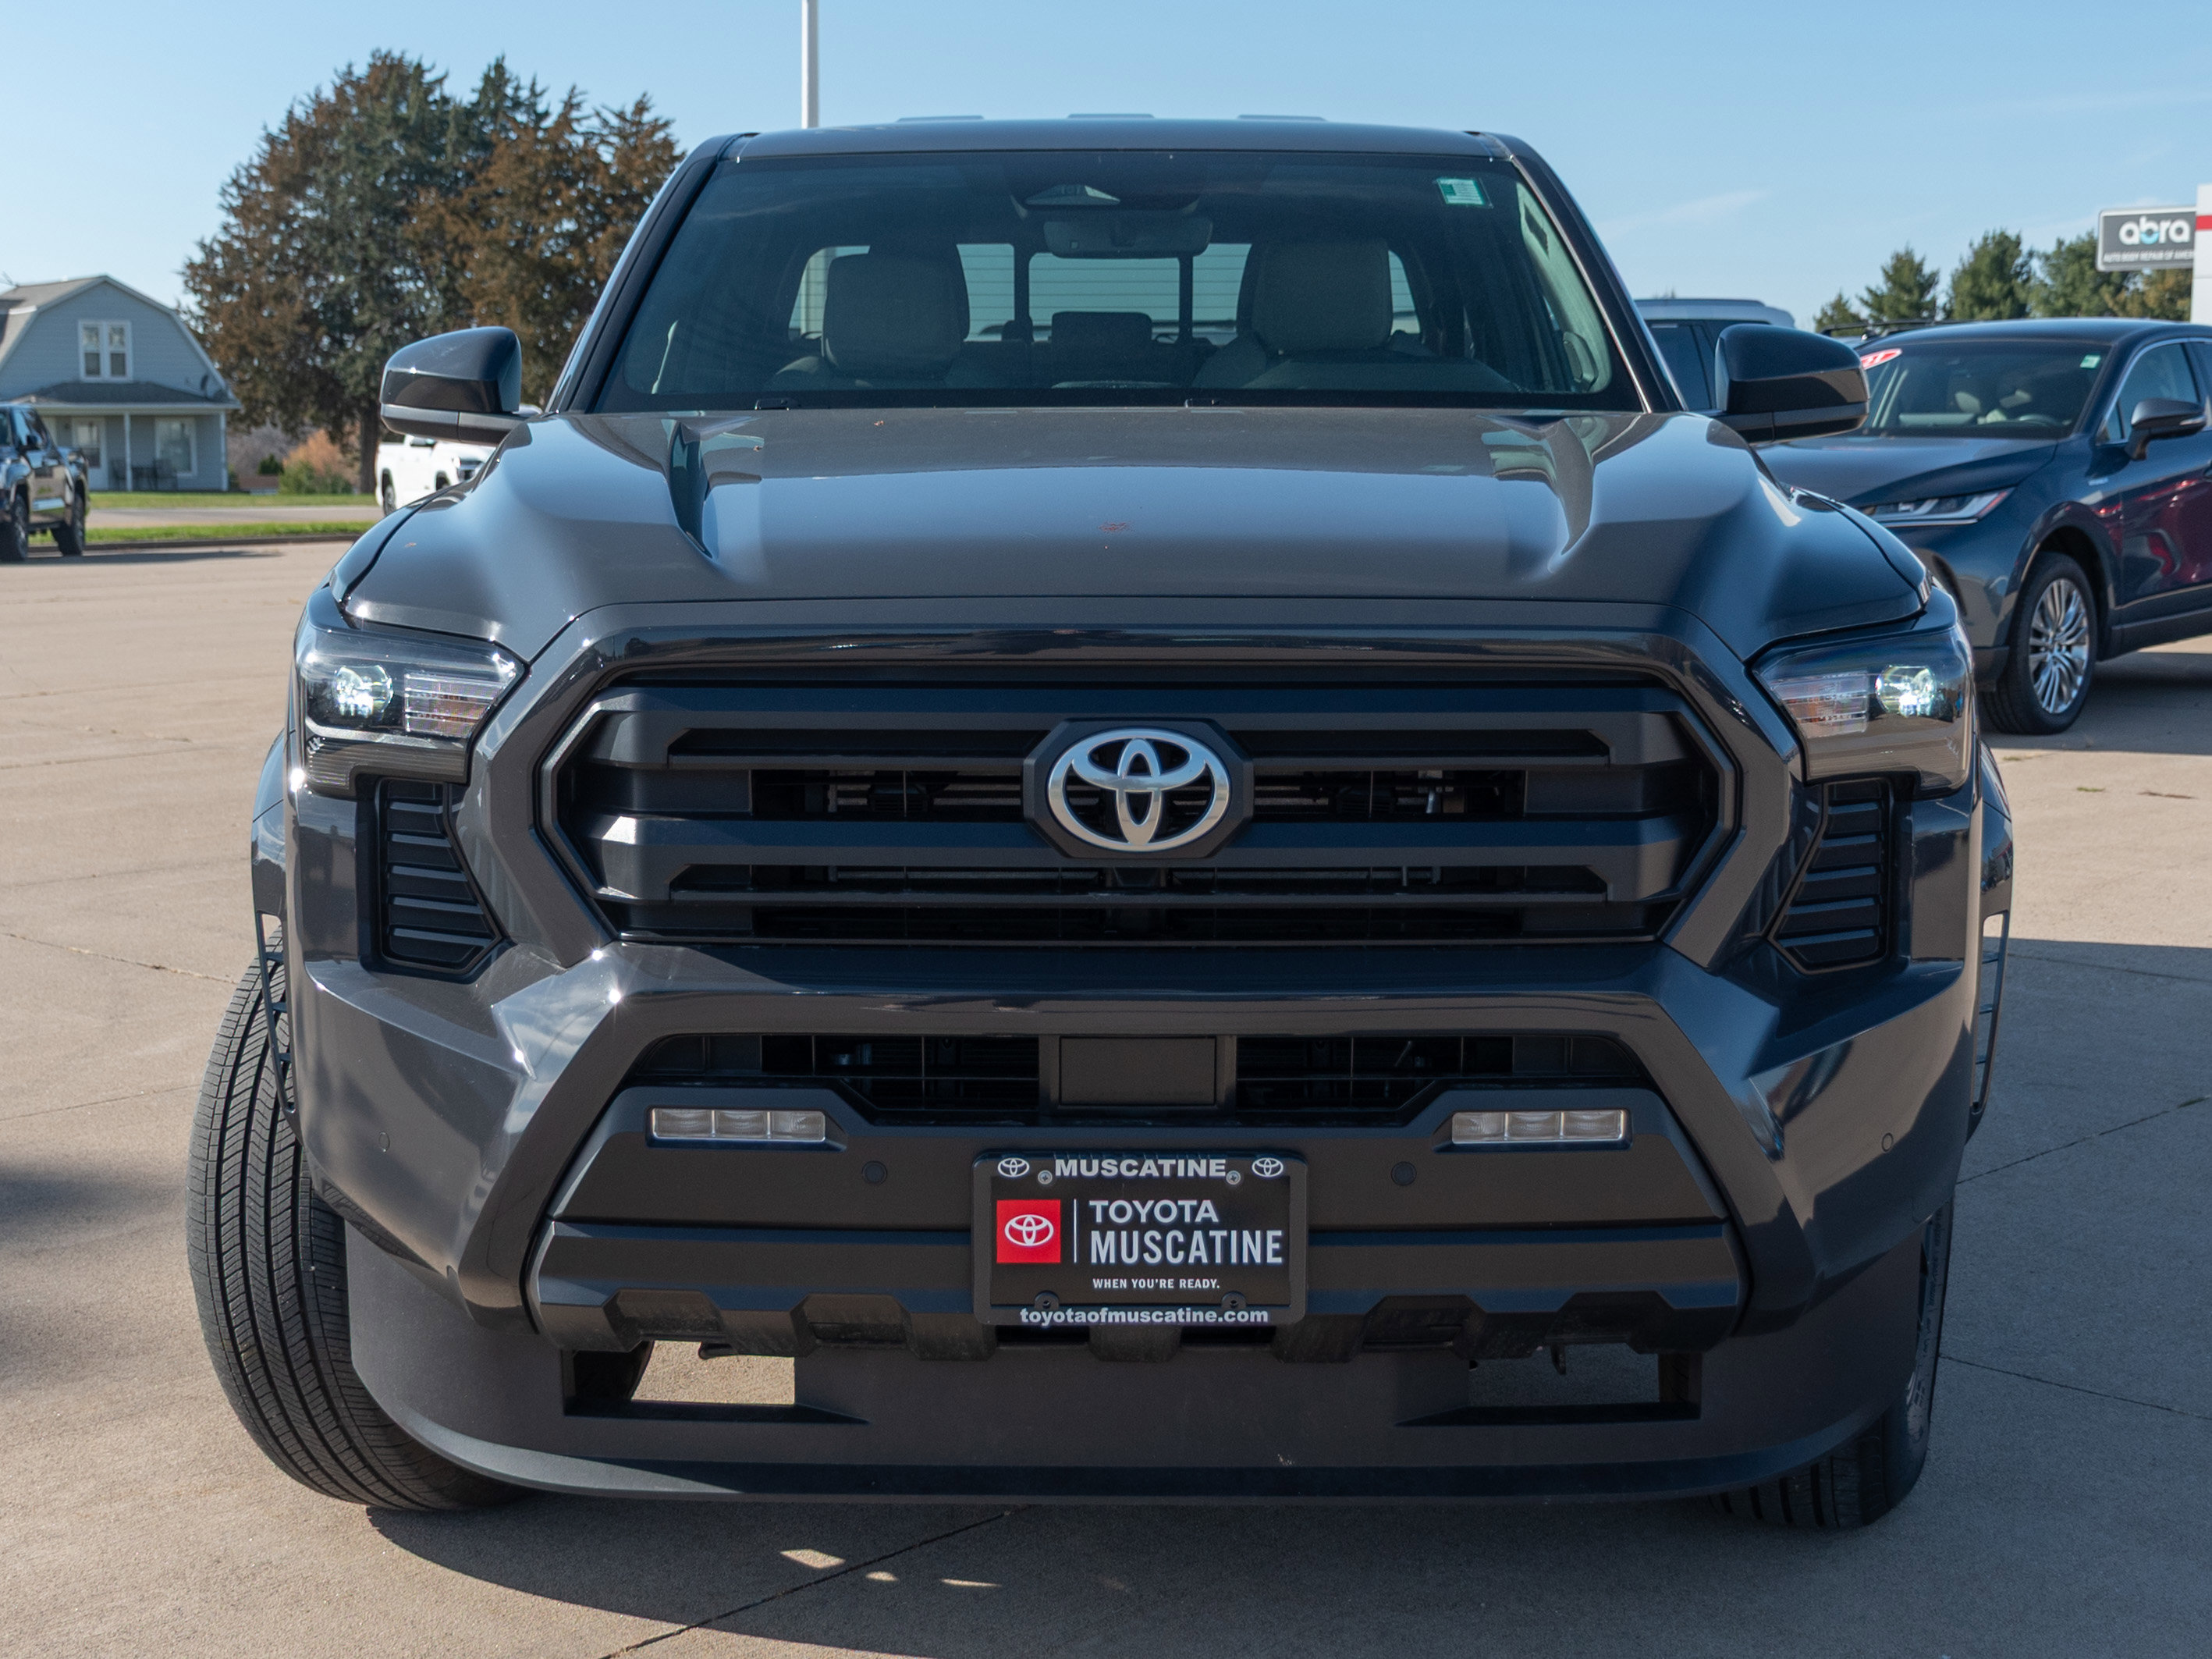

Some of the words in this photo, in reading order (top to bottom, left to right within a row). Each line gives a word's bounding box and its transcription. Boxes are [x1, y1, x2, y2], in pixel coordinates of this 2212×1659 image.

[2119, 215, 2190, 244] abra
[1055, 1159, 1226, 1177] MUSCATINE
[1089, 1199, 1219, 1224] TOYOTA
[1091, 1230, 1282, 1264] MUSCATINE
[1092, 1278, 1127, 1289] WHEN
[1131, 1278, 1174, 1289] YOU'RE
[1179, 1278, 1220, 1289] READY.
[1020, 1307, 1269, 1325] toyotaofmuscatine.com
